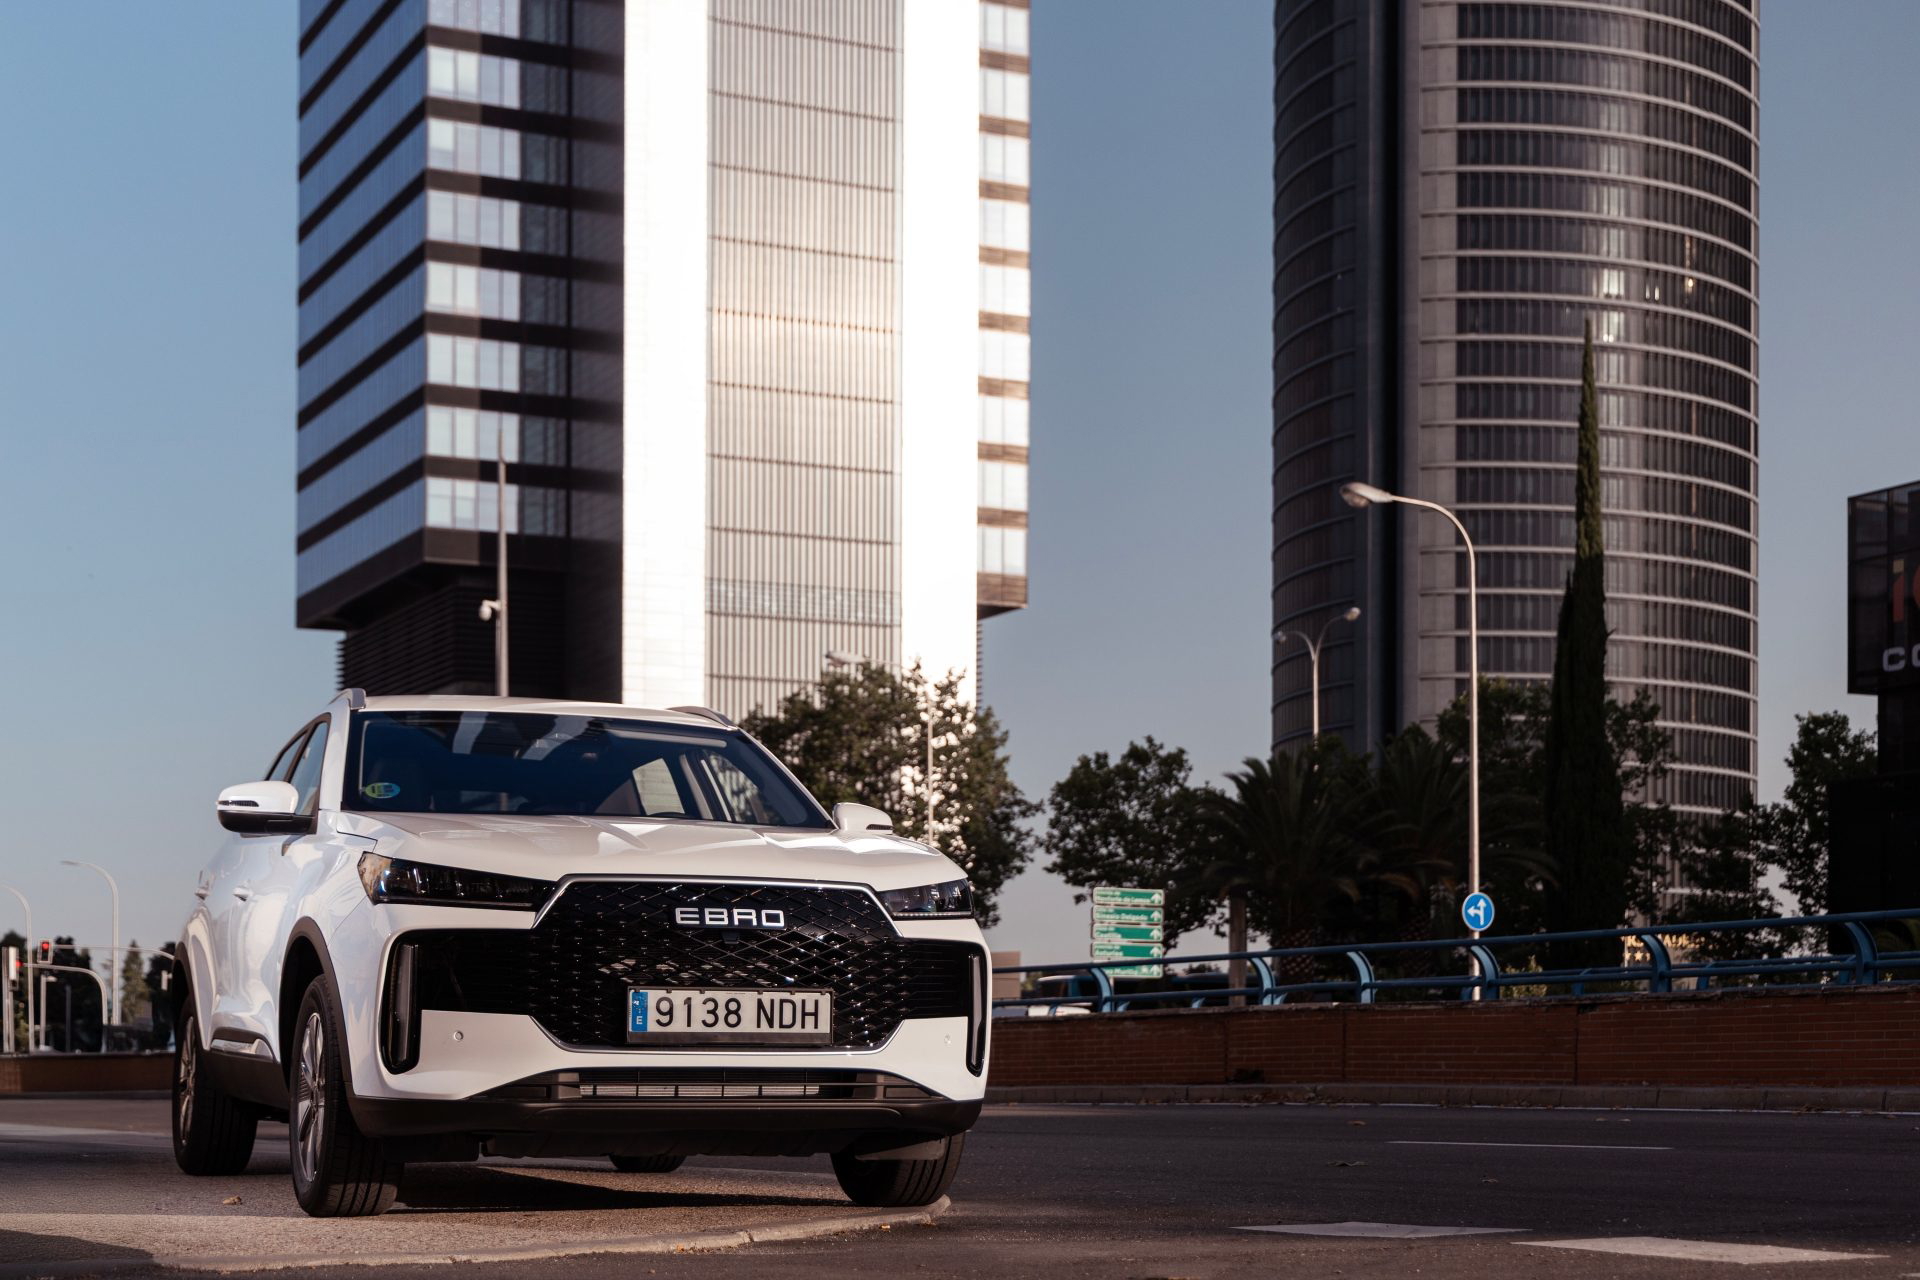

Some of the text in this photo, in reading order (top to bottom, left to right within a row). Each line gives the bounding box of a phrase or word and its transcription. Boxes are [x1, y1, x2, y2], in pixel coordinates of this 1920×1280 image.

[675, 907, 785, 927] EBRO
[635, 1015, 643, 1025] E
[655, 996, 819, 1030] 9138 NDH
